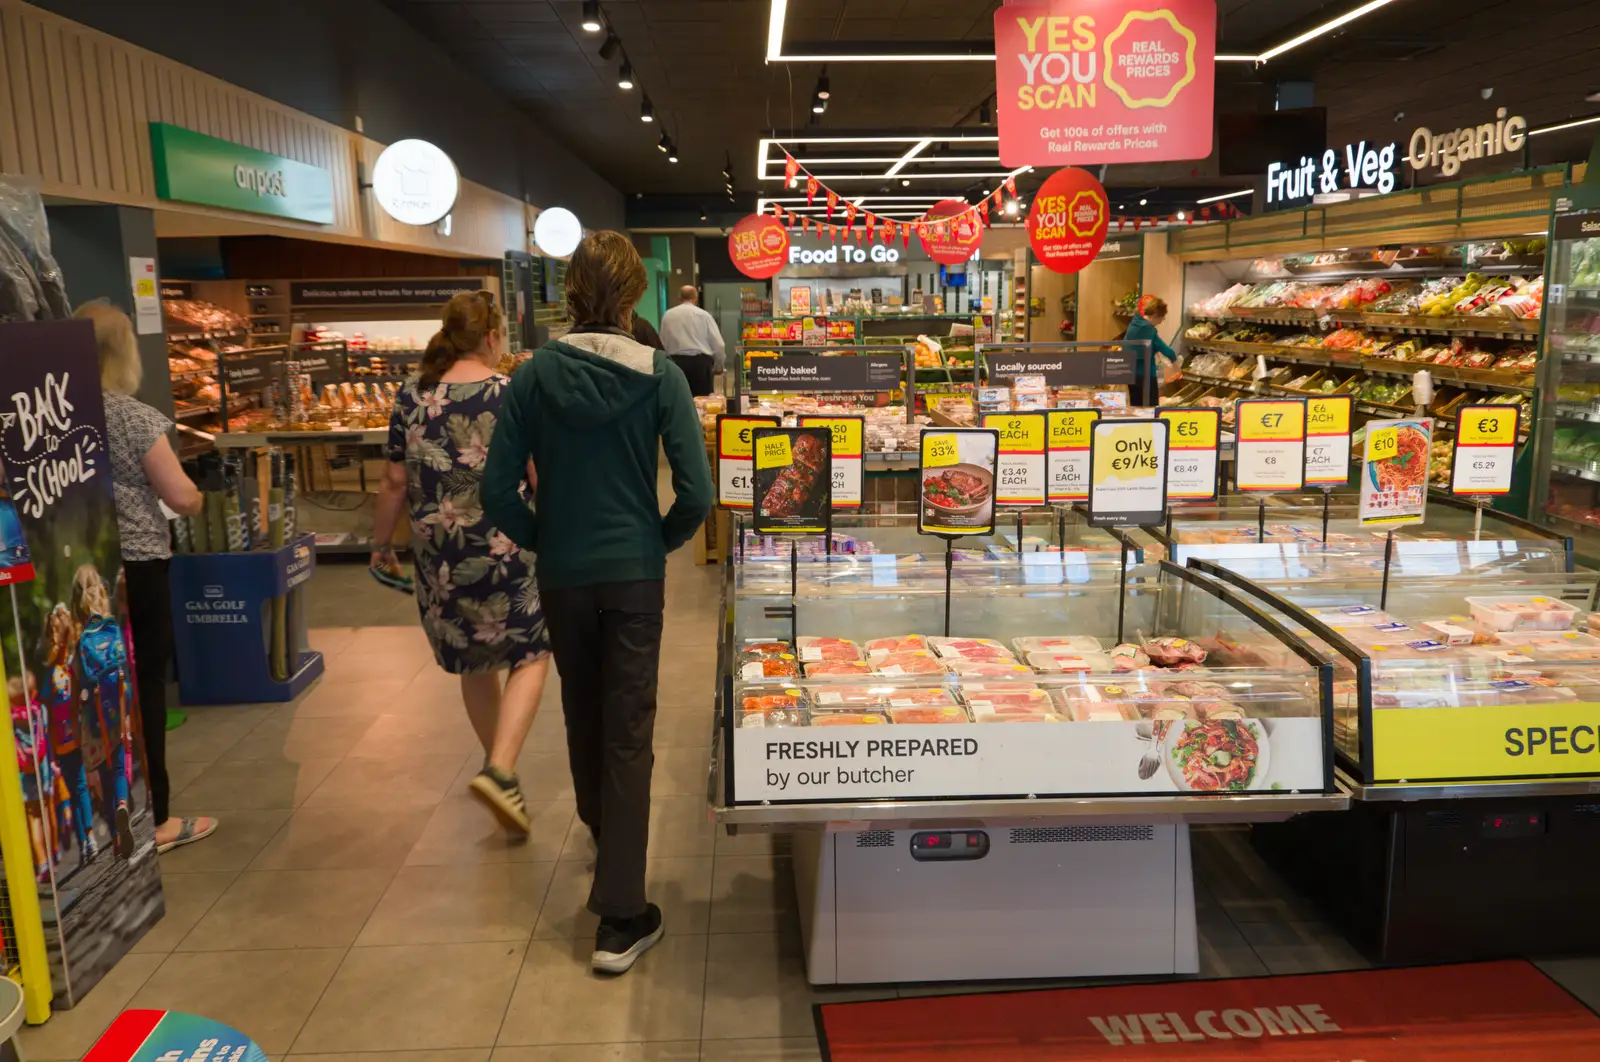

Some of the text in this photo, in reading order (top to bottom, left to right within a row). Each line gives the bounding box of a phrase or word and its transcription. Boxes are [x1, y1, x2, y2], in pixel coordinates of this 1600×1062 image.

[1016, 16, 1096, 52] YES
[1132, 41, 1164, 52] REAL
[1118, 52, 1180, 66] REWARDS
[1018, 52, 1096, 84] YOU
[1126, 65, 1170, 78] PRICES
[1018, 84, 1096, 110] SCAN
[1040, 123, 1166, 139] Get 100s of offers with
[1048, 138, 1158, 153] Real Rewards Prices
[1409, 107, 1527, 176] Organic
[1267, 140, 1396, 203] Fruit & Veg
[1037, 196, 1066, 214] YES
[1036, 212, 1066, 228] YOU
[733, 231, 756, 243] YES
[1036, 226, 1066, 240] SCAN
[735, 241, 758, 252] YOU
[789, 244, 837, 264] Food
[841, 246, 866, 263] To
[870, 244, 899, 262] Go
[401, 288, 412, 296] for
[758, 366, 788, 376] Freshly
[791, 366, 817, 375] baked
[995, 362, 1025, 372] Locally
[1028, 362, 1062, 370] sourced
[11, 372, 74, 452] BACK
[1314, 404, 1326, 413] €6
[1008, 421, 1021, 429] €2
[1061, 417, 1074, 426] €2
[1261, 413, 1283, 428] €7
[1307, 414, 1334, 423] EACH
[1053, 427, 1083, 436] EACH
[1177, 422, 1198, 436] €5
[1478, 419, 1498, 433] €3
[44, 428, 61, 452] to
[832, 435, 847, 443] CH
[1000, 431, 1029, 439] EACH
[764, 442, 785, 450] HALF
[1115, 438, 1152, 452] Only
[1374, 438, 1394, 451] €10
[764, 449, 786, 457] PRICE
[931, 446, 955, 457] 33%
[1112, 455, 1159, 470] €9/kg
[1306, 456, 1330, 464] EACH
[1174, 465, 1198, 473] €8.49
[27, 444, 96, 518] SCHOOL
[832, 472, 844, 480] .99
[1002, 477, 1026, 485] EACH
[1055, 473, 1081, 481] EACH
[185, 601, 246, 610] GAA GOLF
[186, 614, 248, 623] UMBRELLA
[766, 737, 978, 761] FRESHLY PREPARED
[766, 765, 914, 788] by our butcher
[1087, 1004, 1342, 1046] WELCOME
